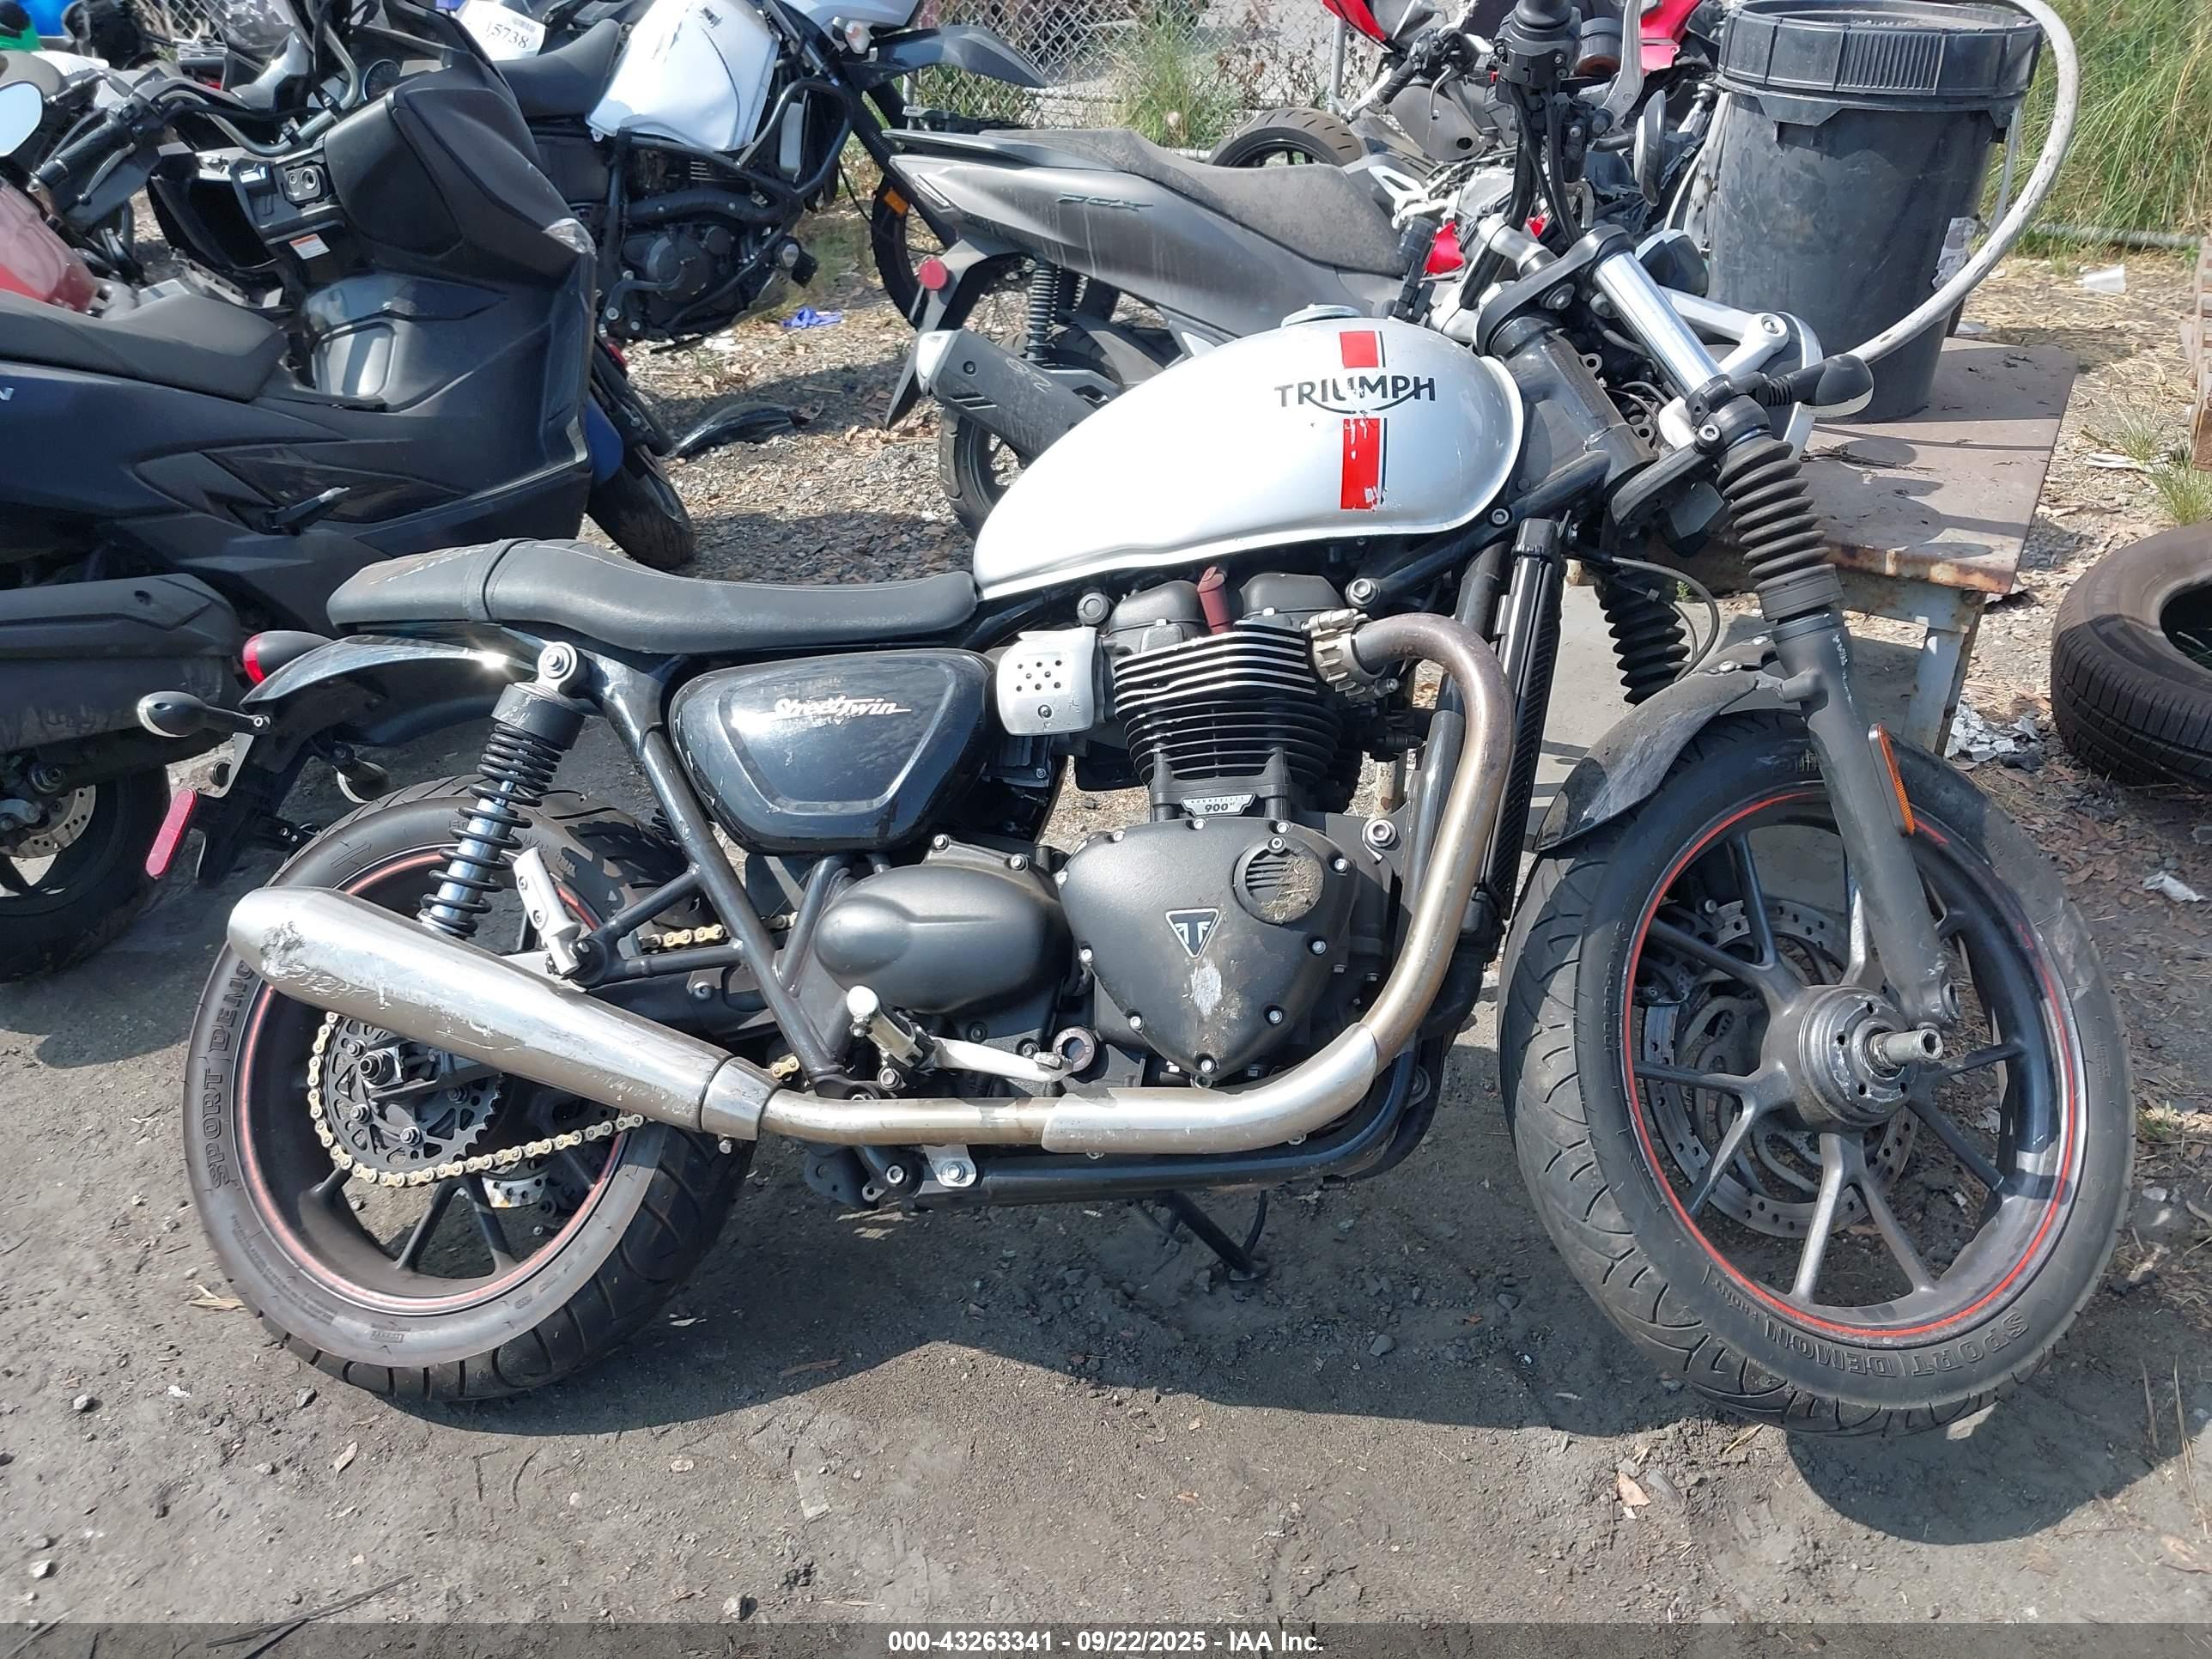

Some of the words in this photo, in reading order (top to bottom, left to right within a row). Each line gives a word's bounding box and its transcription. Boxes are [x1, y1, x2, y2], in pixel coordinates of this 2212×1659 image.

[1273, 374, 1436, 414] TRIUMPH
[1204, 803, 1229, 813] 900
[202, 1067, 229, 1189] SPORT
[1772, 1325, 1898, 1378] DEMON
[1911, 1311, 2030, 1377] SPORT
